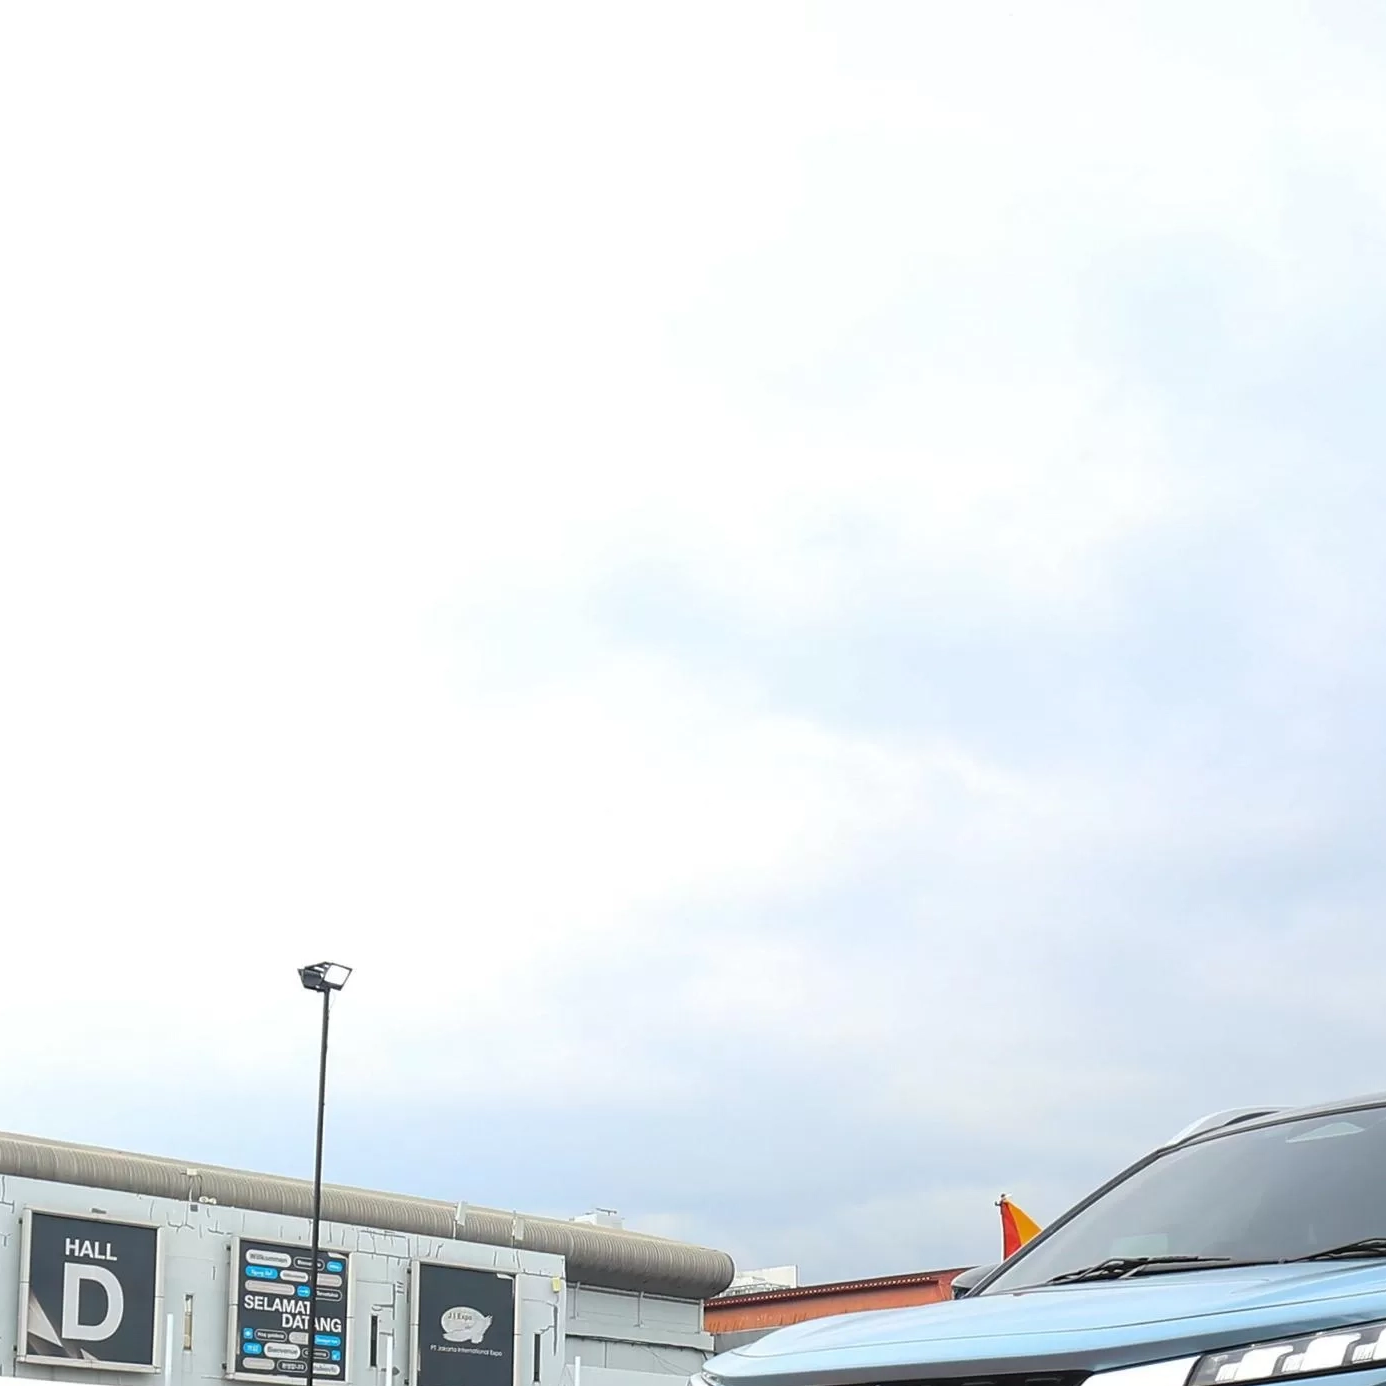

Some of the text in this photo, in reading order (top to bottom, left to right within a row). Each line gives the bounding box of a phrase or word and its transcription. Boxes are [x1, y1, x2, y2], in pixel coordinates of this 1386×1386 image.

[65, 1237, 118, 1262] HALL
[61, 1261, 125, 1342] D
[243, 1294, 311, 1315] SELAMAT
